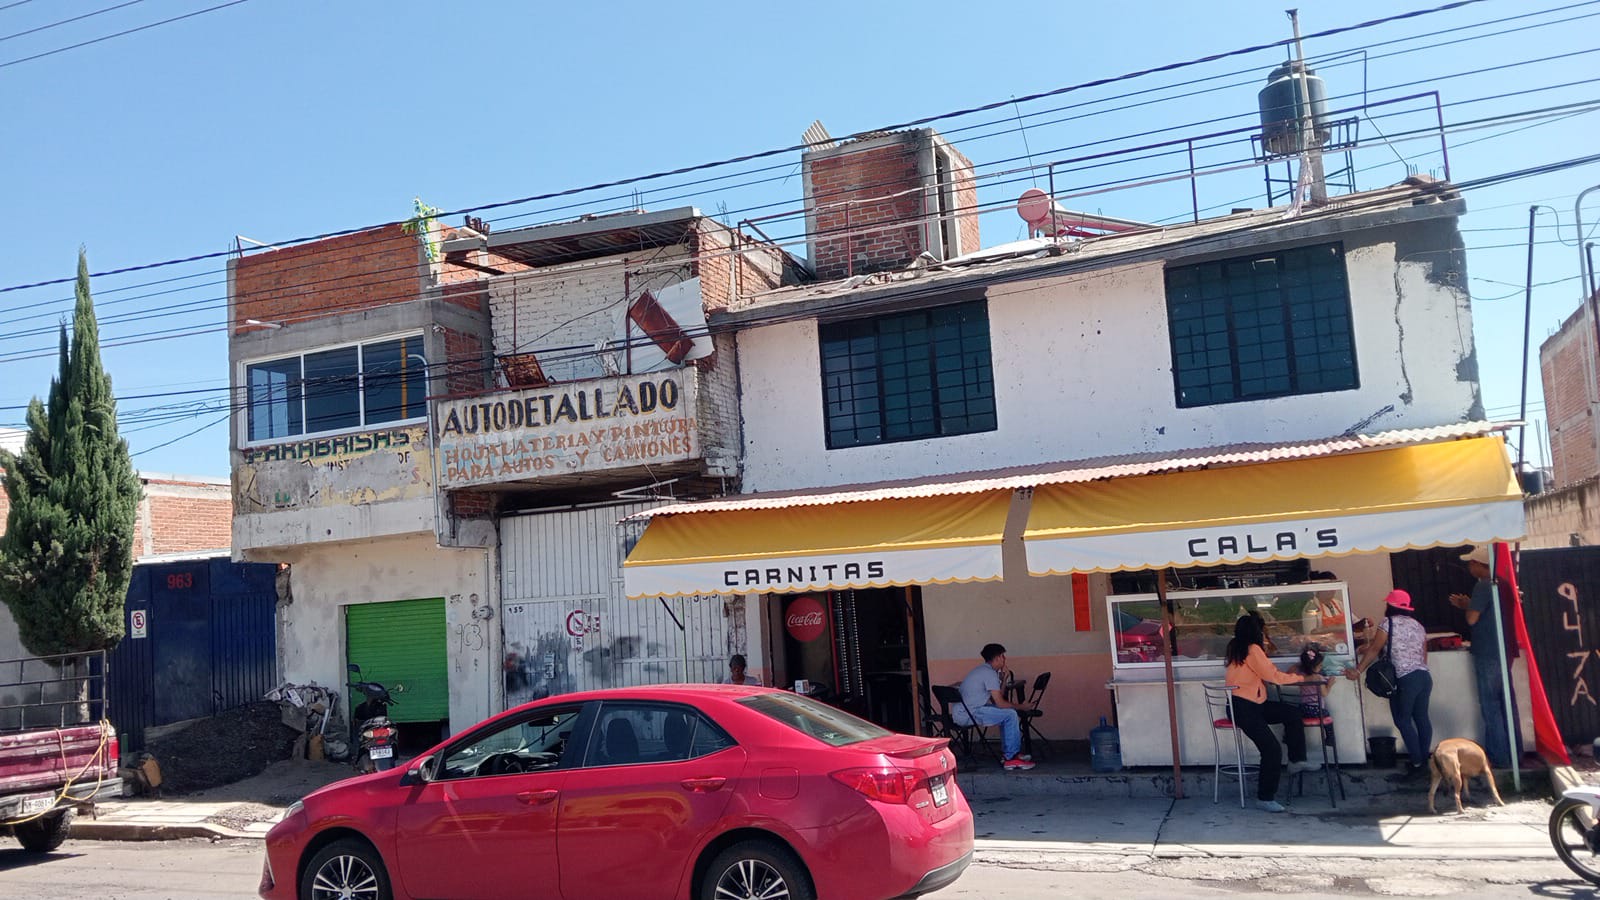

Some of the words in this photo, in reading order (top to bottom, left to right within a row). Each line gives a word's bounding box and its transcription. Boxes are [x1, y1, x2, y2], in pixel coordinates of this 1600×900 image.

[442, 378, 680, 437] AUTODETALLADO
[590, 428, 607, 444] Y
[610, 417, 697, 442] PINTURA
[447, 467, 494, 482] PARA
[499, 454, 555, 476] AUTOS
[576, 449, 590, 465] Y
[602, 436, 693, 463] CAMIONES
[1188, 527, 1338, 558] CALA'S
[167, 572, 193, 589] 963
[724, 561, 884, 586] CARNITAS
